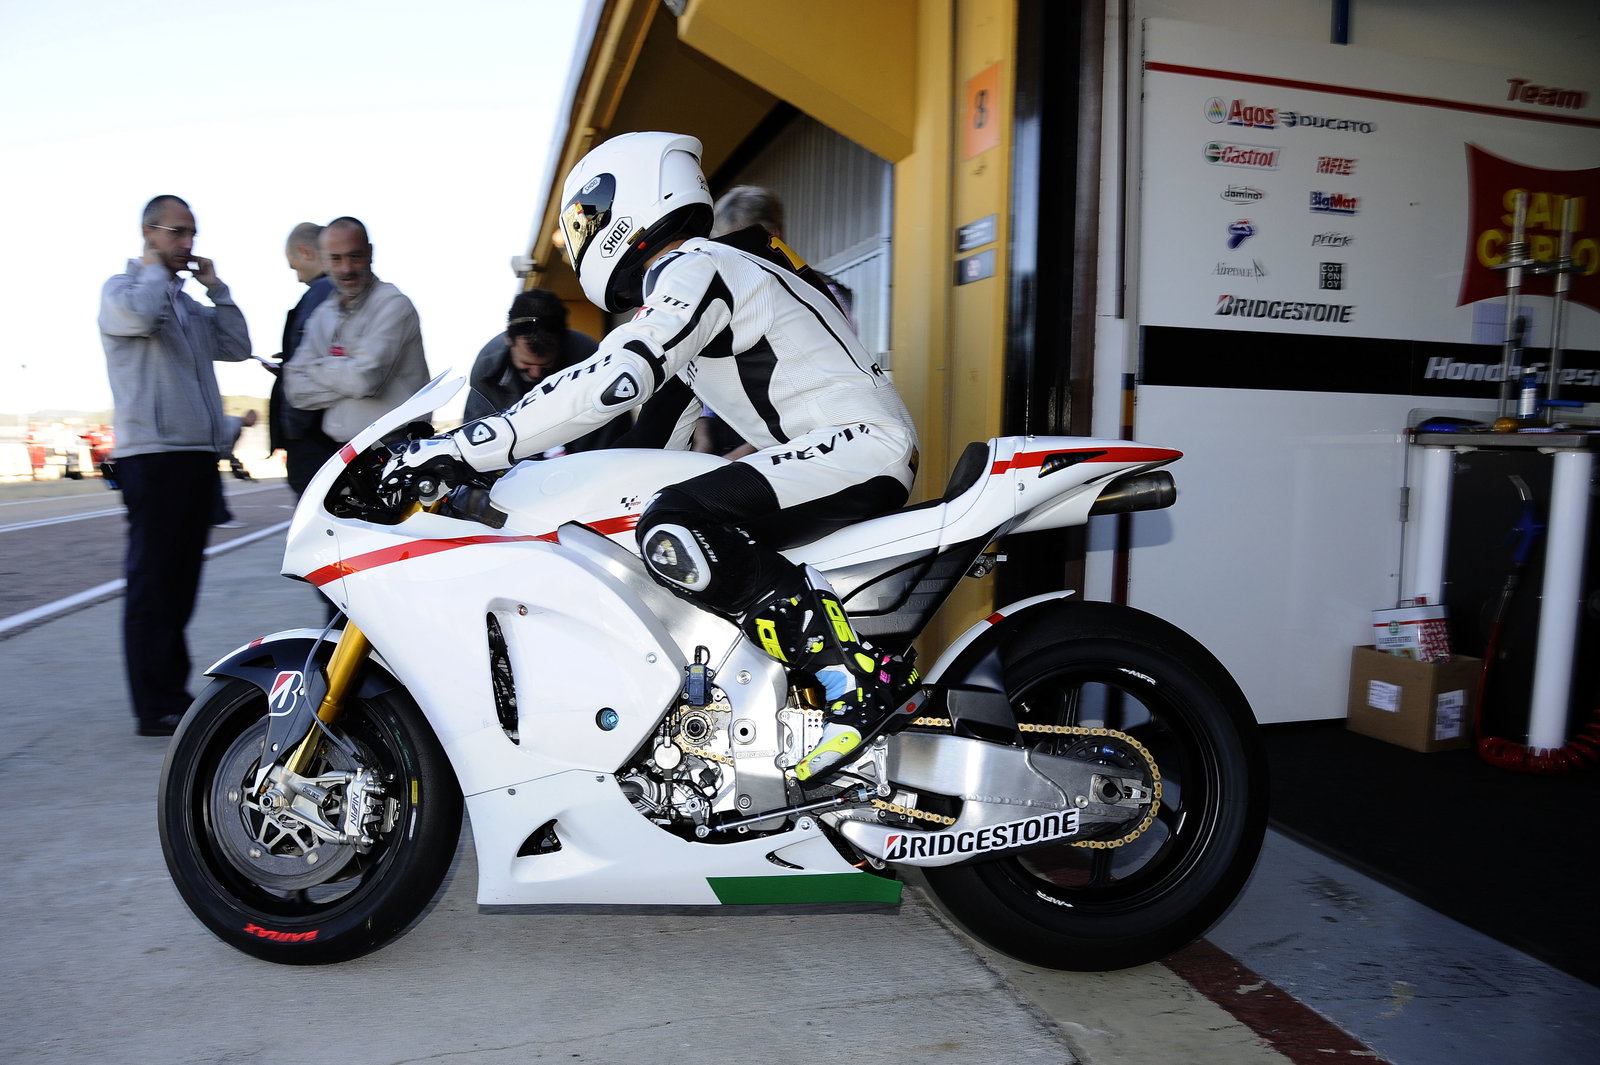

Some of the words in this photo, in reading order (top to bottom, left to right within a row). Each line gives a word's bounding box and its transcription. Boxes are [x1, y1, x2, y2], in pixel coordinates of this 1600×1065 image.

[1506, 78, 1588, 109] Team
[1227, 99, 1277, 128] Agos
[1300, 114, 1375, 134] DUCATO
[1221, 146, 1274, 168] Castrol
[1310, 191, 1358, 211] BigMat
[603, 220, 630, 254] SHOEI
[1214, 294, 1355, 323] BRIDGESTONE
[1424, 357, 1522, 382] Hond
[886, 811, 1078, 860] BRIDGESTONE
